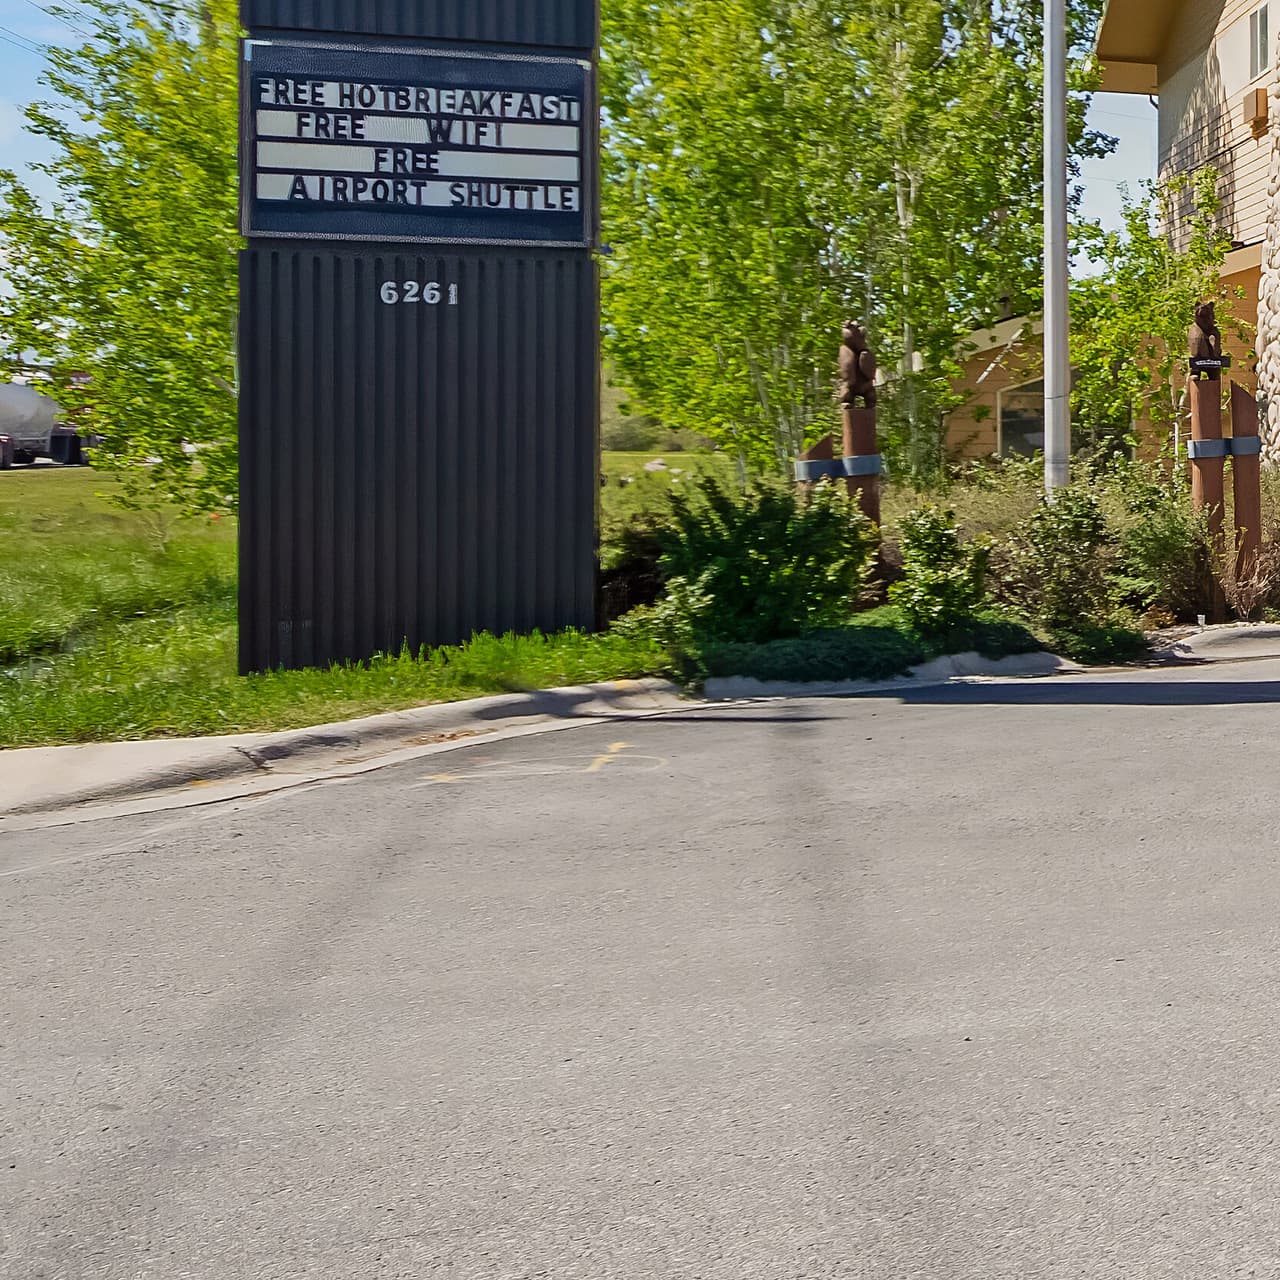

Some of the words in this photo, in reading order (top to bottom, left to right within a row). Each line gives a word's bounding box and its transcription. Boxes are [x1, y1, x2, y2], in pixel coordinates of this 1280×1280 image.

[258, 79, 325, 107] FREE
[297, 112, 366, 140] FREE
[427, 118, 502, 147] WIFI
[374, 148, 440, 174] FREE
[289, 174, 427, 206] AIRPORT
[450, 182, 575, 211] SHUTTLE
[380, 280, 458, 305] 6261
